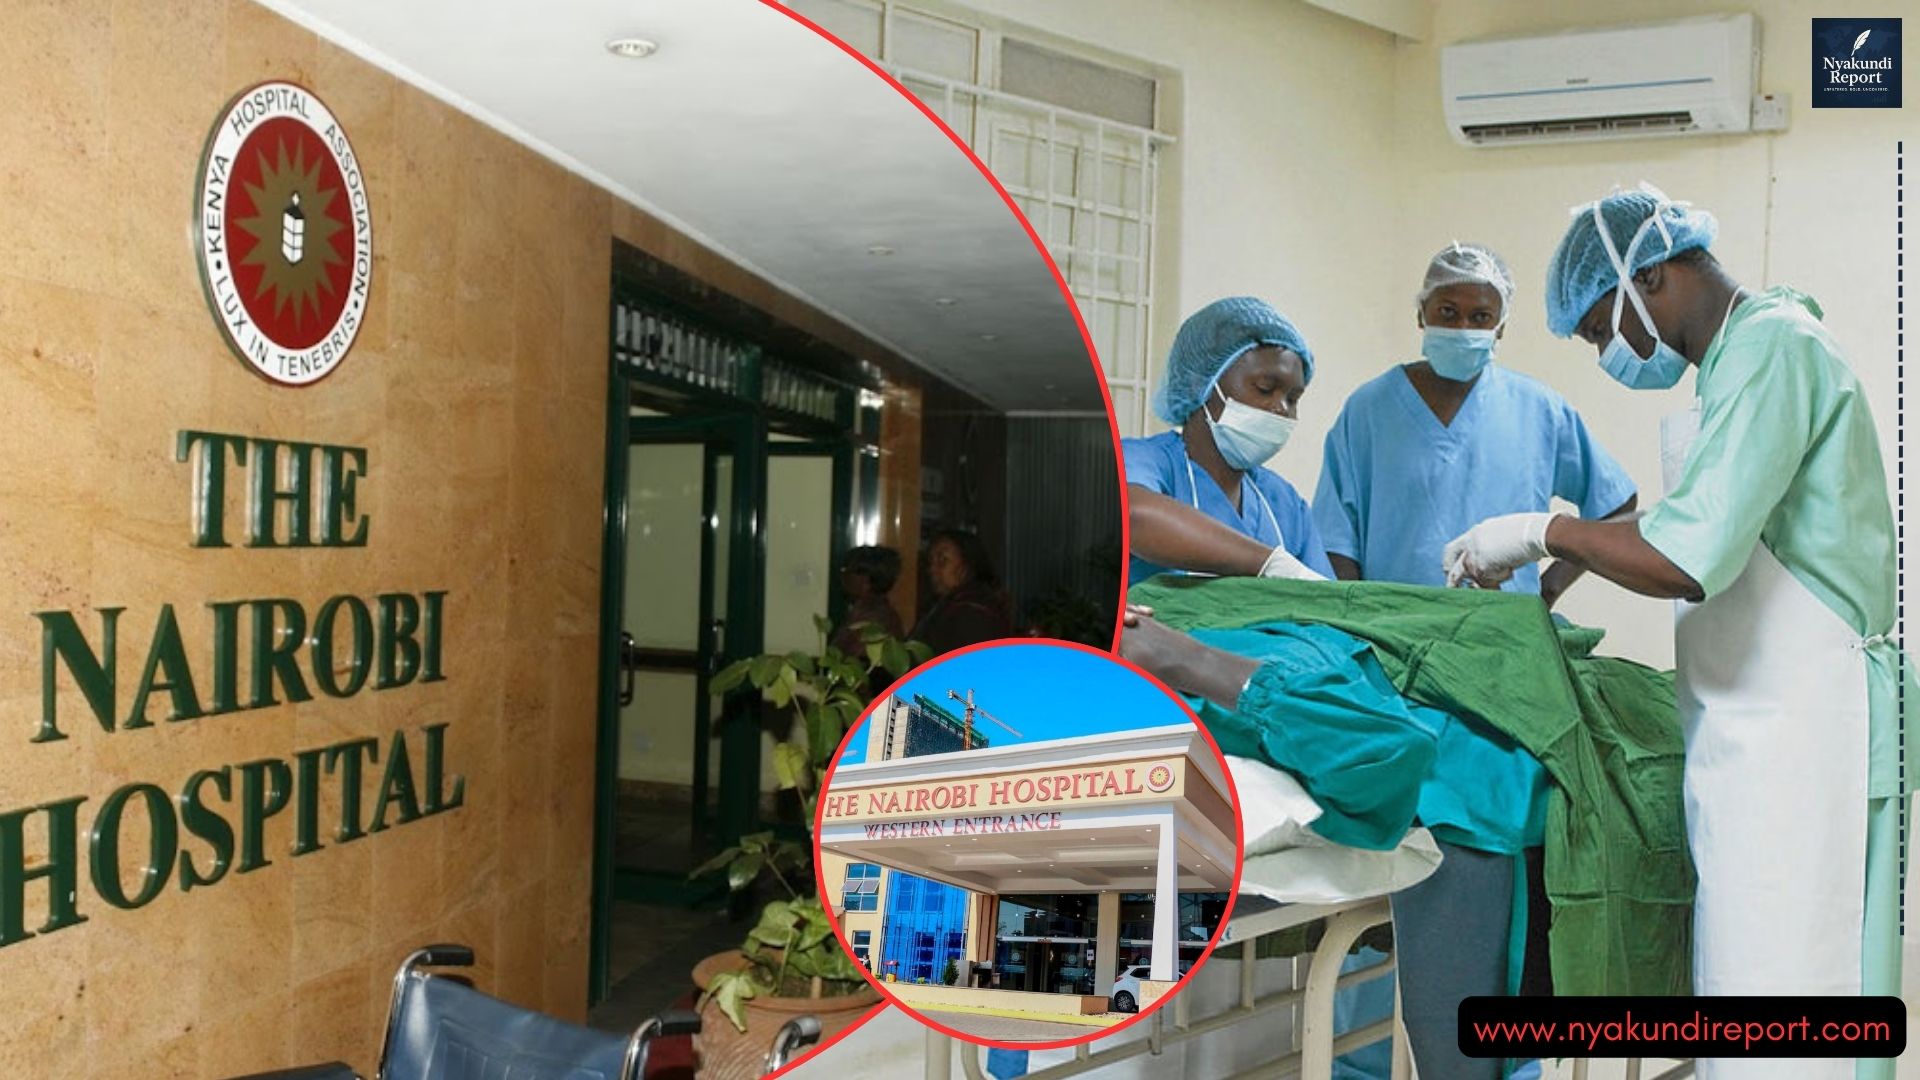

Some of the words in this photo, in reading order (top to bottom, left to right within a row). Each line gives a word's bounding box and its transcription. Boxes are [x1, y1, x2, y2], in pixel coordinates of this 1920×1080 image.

[207, 155, 230, 253] KENYA
[231, 88, 310, 136] HOSPITAL
[325, 124, 369, 296] ASSOCIATION
[216, 275, 248, 336] LUX
[250, 334, 269, 364] IN
[277, 311, 356, 377] TENEBRIS
[176, 430, 370, 548] THE
[30, 591, 450, 744] NAIROBI
[0, 723, 466, 948] HOSPITAL
[825, 793, 860, 818] HE
[867, 783, 980, 815] NAIROBI
[988, 768, 1144, 806] HOSPITAL
[863, 819, 945, 840] WESTERN
[952, 811, 1062, 836] ENTRANCE
